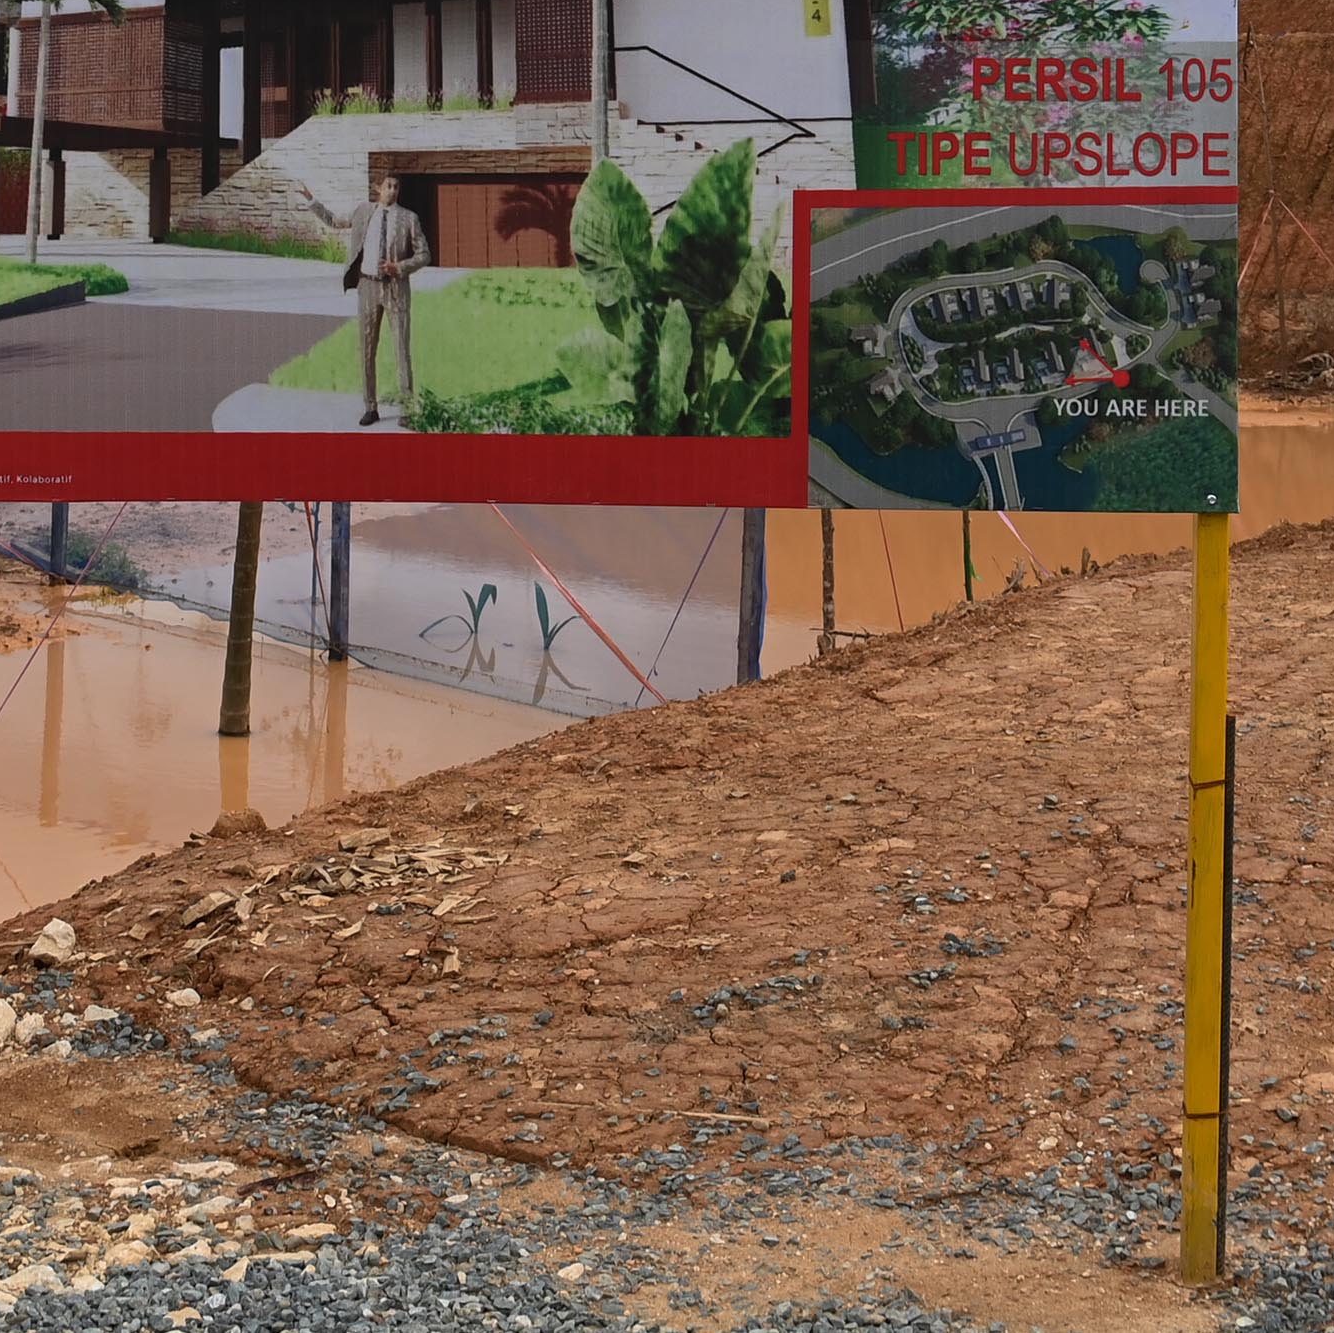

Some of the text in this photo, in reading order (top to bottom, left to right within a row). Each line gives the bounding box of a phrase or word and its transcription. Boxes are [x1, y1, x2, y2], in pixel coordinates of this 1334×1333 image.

[972, 58, 1234, 103] PERSIL 105
[887, 132, 1230, 176] TIPE UPSLOPE
[1054, 399, 1209, 417] YOU ARE HERE
[17, 475, 73, 484] Kolaboratif
